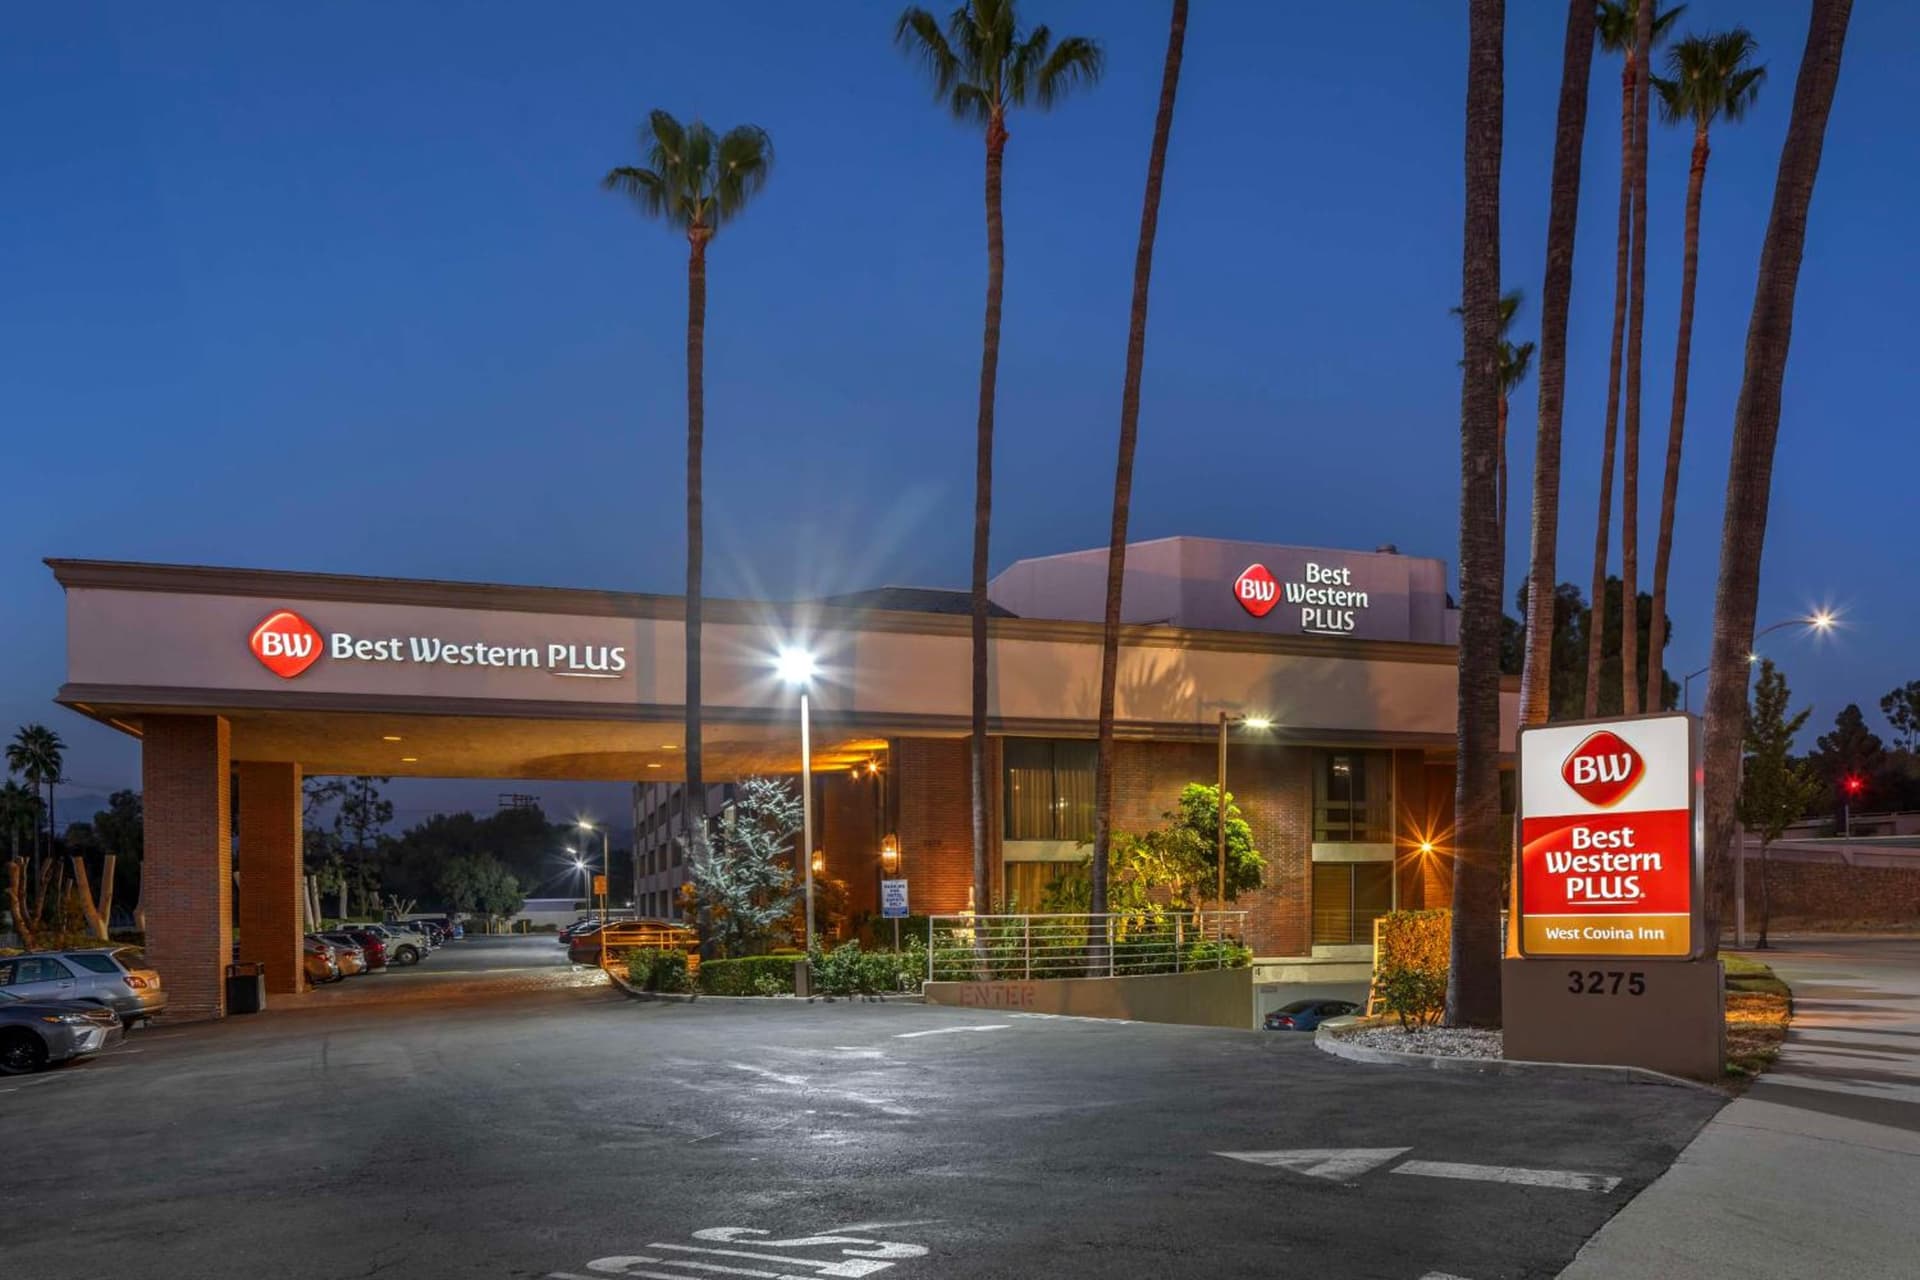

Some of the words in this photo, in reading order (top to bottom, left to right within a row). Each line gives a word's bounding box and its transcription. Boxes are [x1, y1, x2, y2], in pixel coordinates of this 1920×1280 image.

[1306, 562, 1351, 585] Best
[1241, 579, 1275, 601] BW
[1286, 583, 1368, 608] Western
[1301, 607, 1355, 631] PLUS
[262, 632, 312, 657] BW
[331, 633, 403, 661] Best
[409, 637, 540, 668] Western
[548, 644, 626, 672] PLUS
[1573, 753, 1632, 784] BW
[1572, 827, 1635, 849] Best
[1545, 851, 1662, 873] Western
[1546, 927, 1580, 940] West
[1583, 926, 1634, 940] Covina
[1638, 927, 1665, 940] Inn
[959, 984, 1035, 1006] ENTER
[1567, 970, 1646, 996] 3275
[546, 1227, 929, 1280] STO
